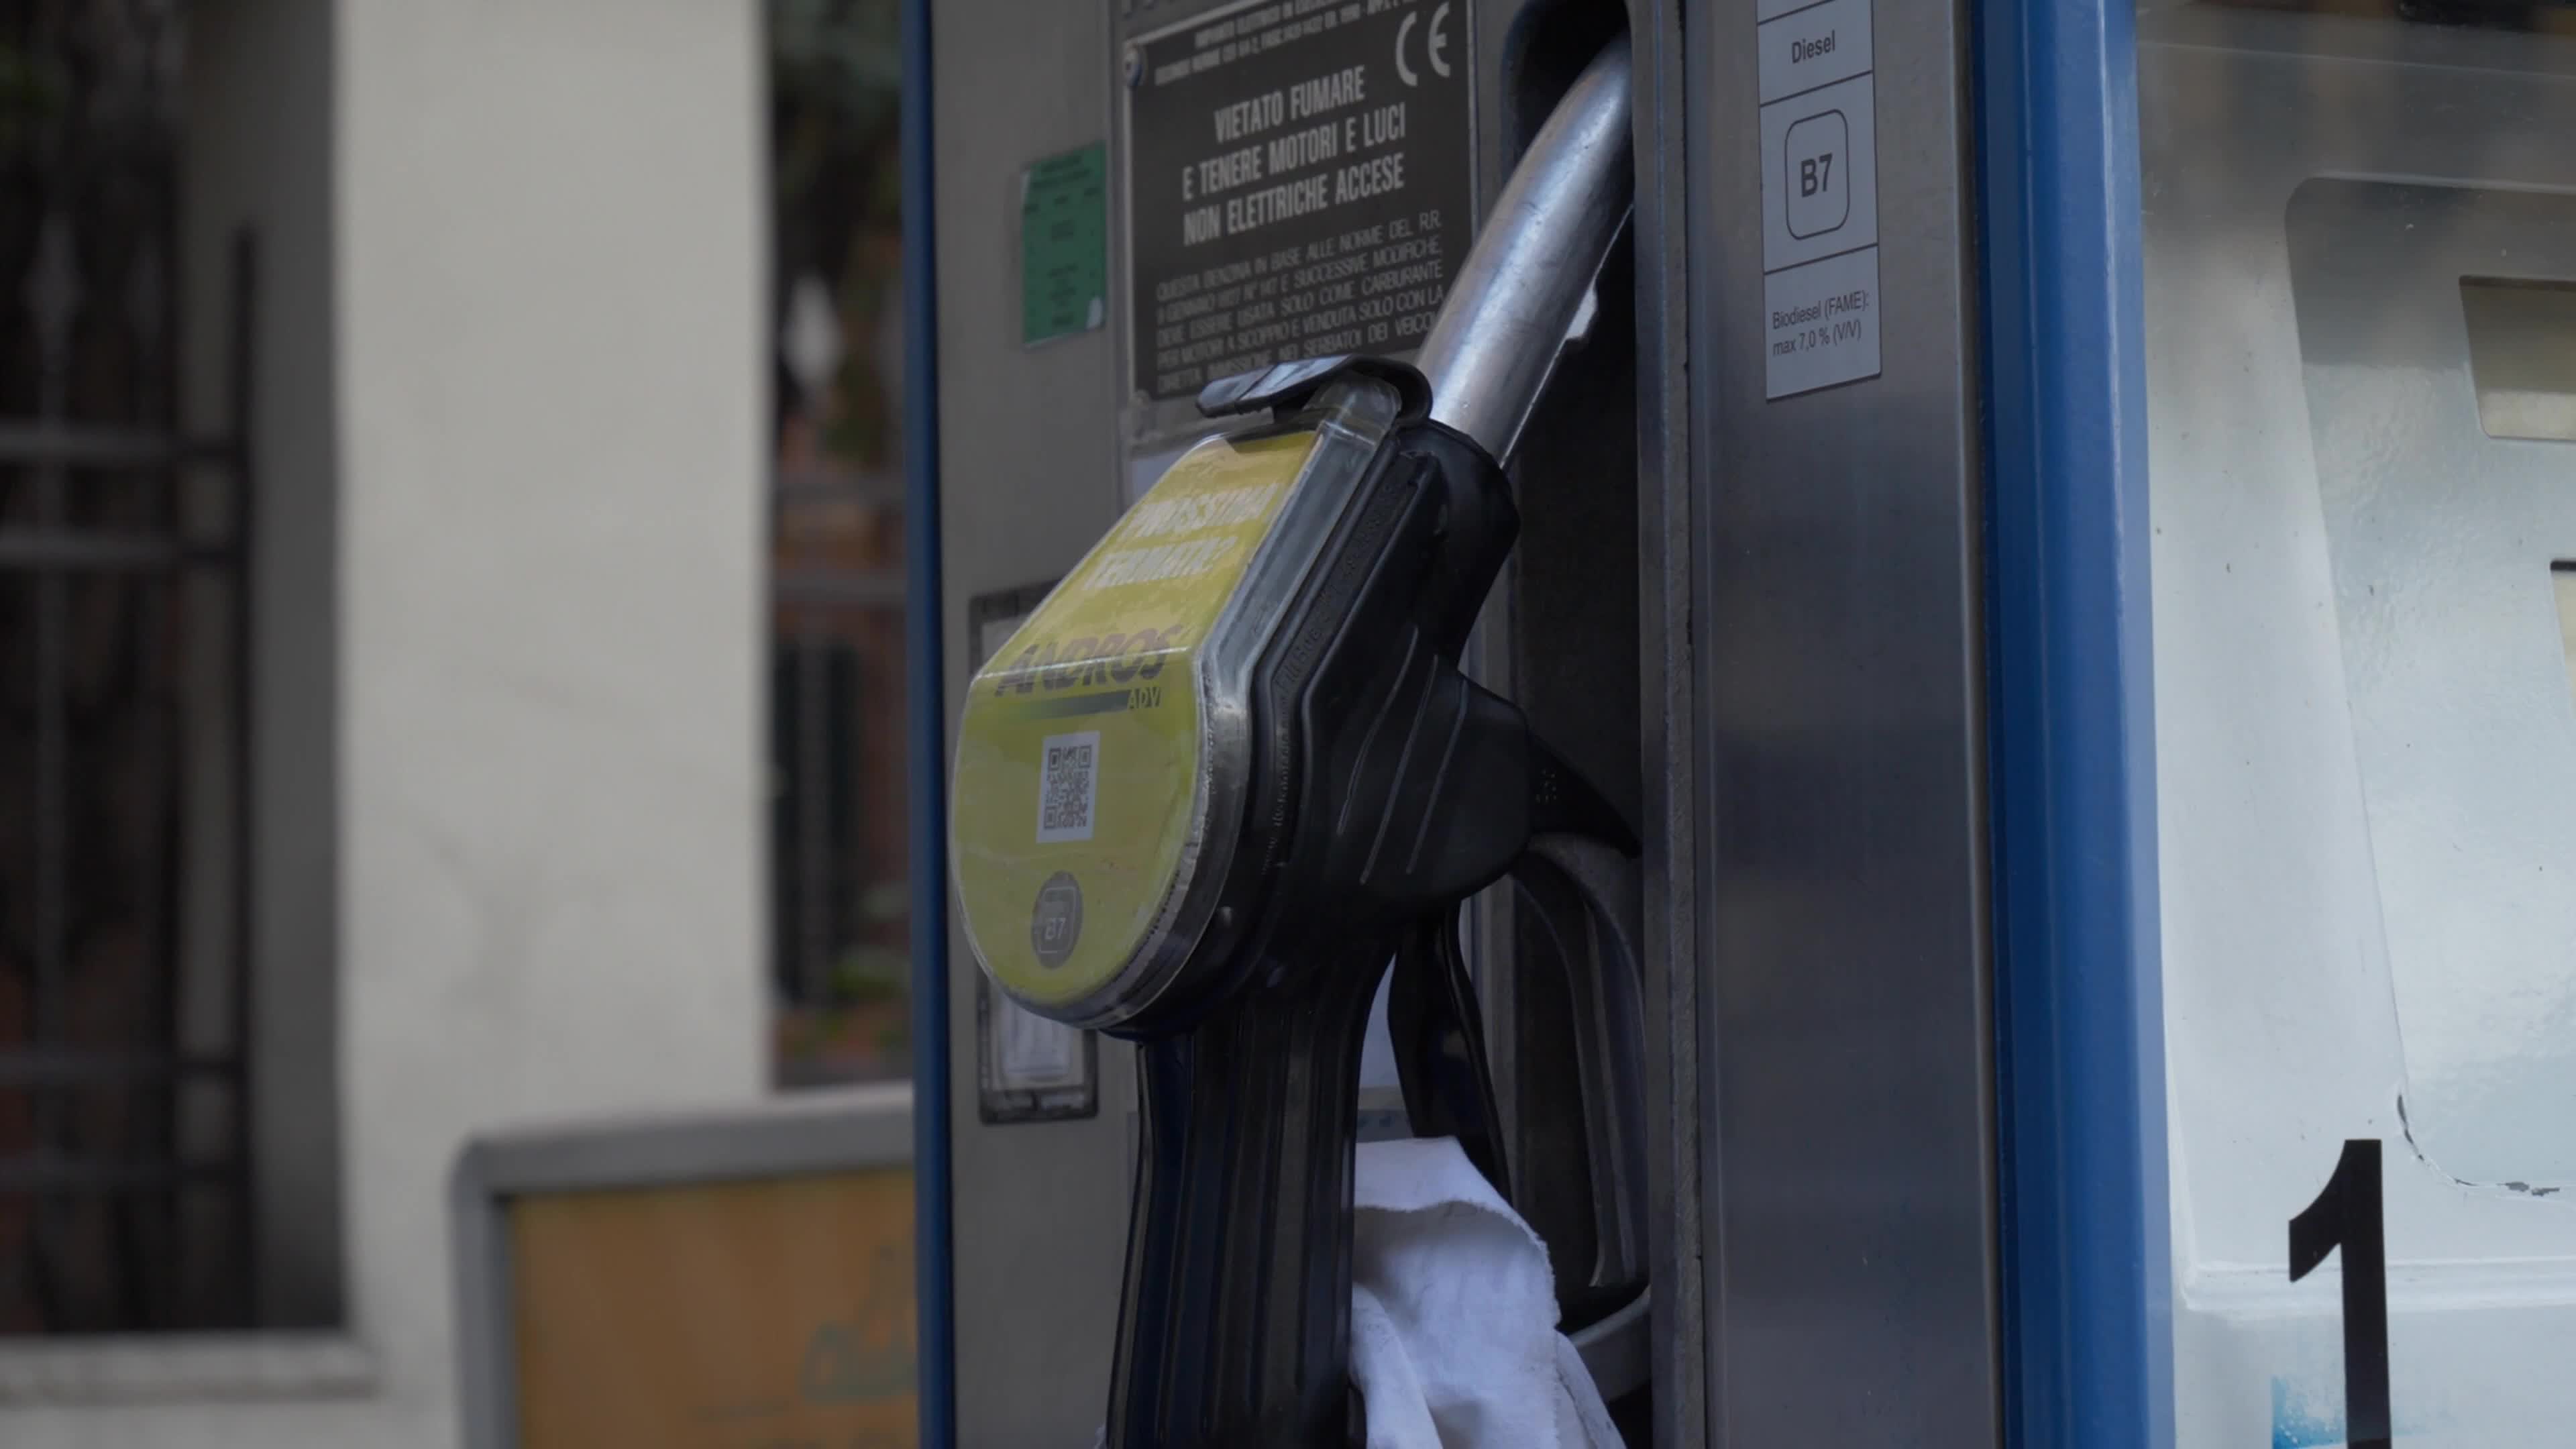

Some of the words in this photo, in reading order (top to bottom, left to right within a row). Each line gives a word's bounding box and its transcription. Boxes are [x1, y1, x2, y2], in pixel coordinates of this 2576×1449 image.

[1792, 30, 1836, 64] Diesel
[1214, 91, 1283, 144] VIETATO
[1290, 65, 1366, 121] FUMARE
[1183, 166, 1194, 201] E
[1199, 146, 1263, 195] TENERE
[1269, 123, 1338, 175] MOTORI
[1345, 117, 1356, 153] E
[1364, 102, 1406, 148] LUCI
[1801, 152, 1833, 198] B7
[1183, 205, 1220, 247] NON
[1227, 173, 1328, 235] ELETTRICHE
[1336, 153, 1404, 204] ACCESE
[1271, 246, 1301, 272] BASE
[1307, 237, 1336, 259] ALLE
[1340, 225, 1383, 252] NORME
[1389, 218, 1413, 239] DEL
[1281, 272, 1289, 292] E
[1293, 252, 1368, 289] SUCCESSIVE
[1280, 291, 1315, 318] SOLO
[1320, 280, 1355, 305] COME
[1361, 260, 1444, 296] CARBURANTE
[1291, 317, 1301, 338] E
[1303, 305, 1357, 334] VENDUTA
[1358, 297, 1394, 321] SOLO
[1396, 289, 1426, 313] CON
[1427, 284, 1444, 305] LA
[1772, 300, 1821, 329] Biodiesel
[1825, 290, 1870, 321] (FAME):
[1367, 321, 1389, 344] DEI
[1773, 339, 1796, 357] max
[1799, 332, 1816, 352] 7,0
[1819, 327, 1831, 346] %
[994, 624, 1185, 698] ANDROS
[1128, 686, 1163, 710] ADV
[2289, 1139, 2392, 1449] 1
